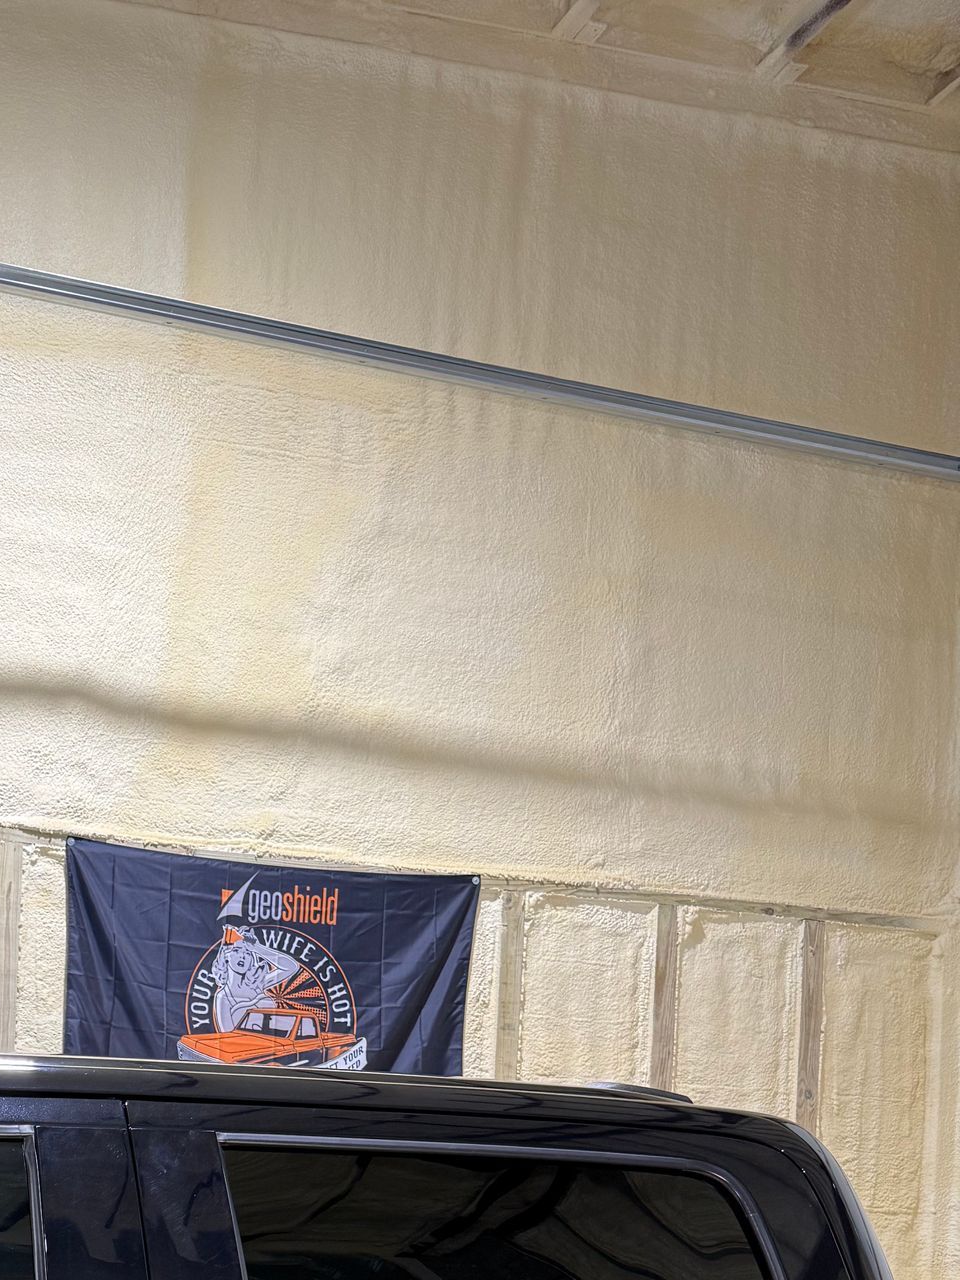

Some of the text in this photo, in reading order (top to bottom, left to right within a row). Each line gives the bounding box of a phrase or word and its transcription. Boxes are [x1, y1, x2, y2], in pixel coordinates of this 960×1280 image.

[248, 885, 339, 926] geoshield
[190, 929, 351, 1029] YOUR WIFE IS HOT
[343, 1045, 364, 1065] YOUR
